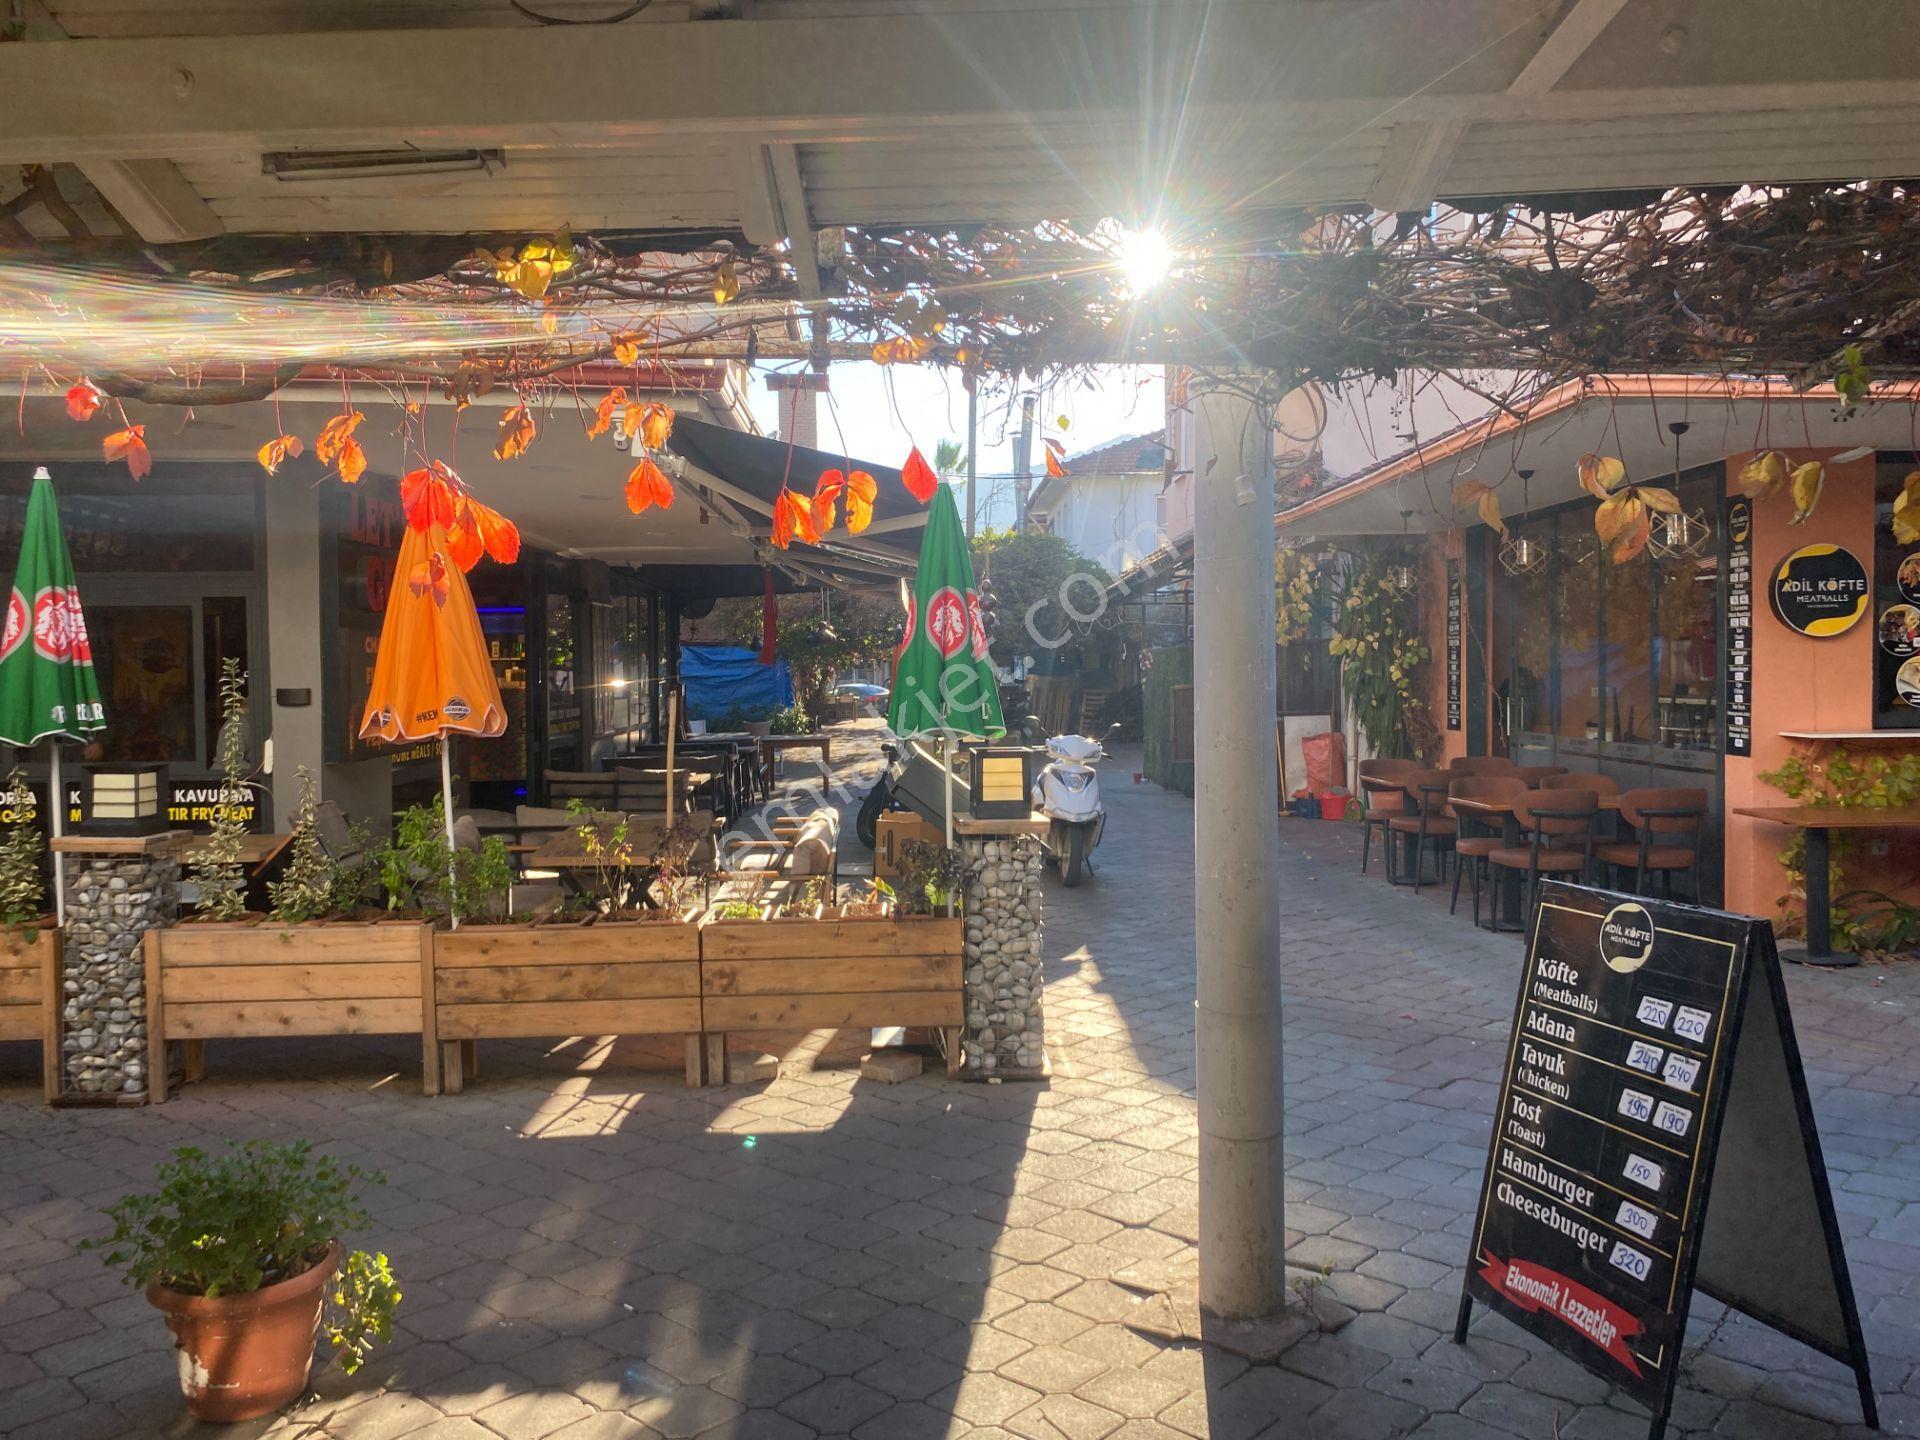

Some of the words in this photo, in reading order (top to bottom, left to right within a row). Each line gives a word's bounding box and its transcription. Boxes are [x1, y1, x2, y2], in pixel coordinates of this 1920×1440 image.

[1796, 594, 1849, 603] MEATBALLS
[1818, 577, 1864, 592] KÖFTE
[1624, 927, 1651, 942] KÖFTE
[1537, 957, 1579, 986] Köfte
[1533, 981, 1598, 1014] (Meatballs)
[1526, 1010, 1576, 1042] Adana
[1642, 1005, 1667, 1026] 220
[1678, 1016, 1704, 1036] 220
[1522, 1042, 1566, 1076] Tavuk
[1632, 1049, 1659, 1072] 240
[1668, 1064, 1692, 1083] 240
[1517, 1066, 1570, 1100] (Chicken)
[1512, 1095, 1542, 1124] Tost
[1627, 1098, 1649, 1119] 190
[1661, 1111, 1685, 1132] 190
[1508, 1119, 1546, 1150] (Toast)
[1502, 1148, 1594, 1207] Hamburger
[1630, 1162, 1650, 1180] 150
[1497, 1182, 1608, 1253] Cheeseburger
[1623, 1208, 1648, 1230] 300
[1614, 1248, 1645, 1275] 320
[1505, 1265, 1560, 1309] Ekonomik
[1560, 1287, 1617, 1347] Lezzetler
